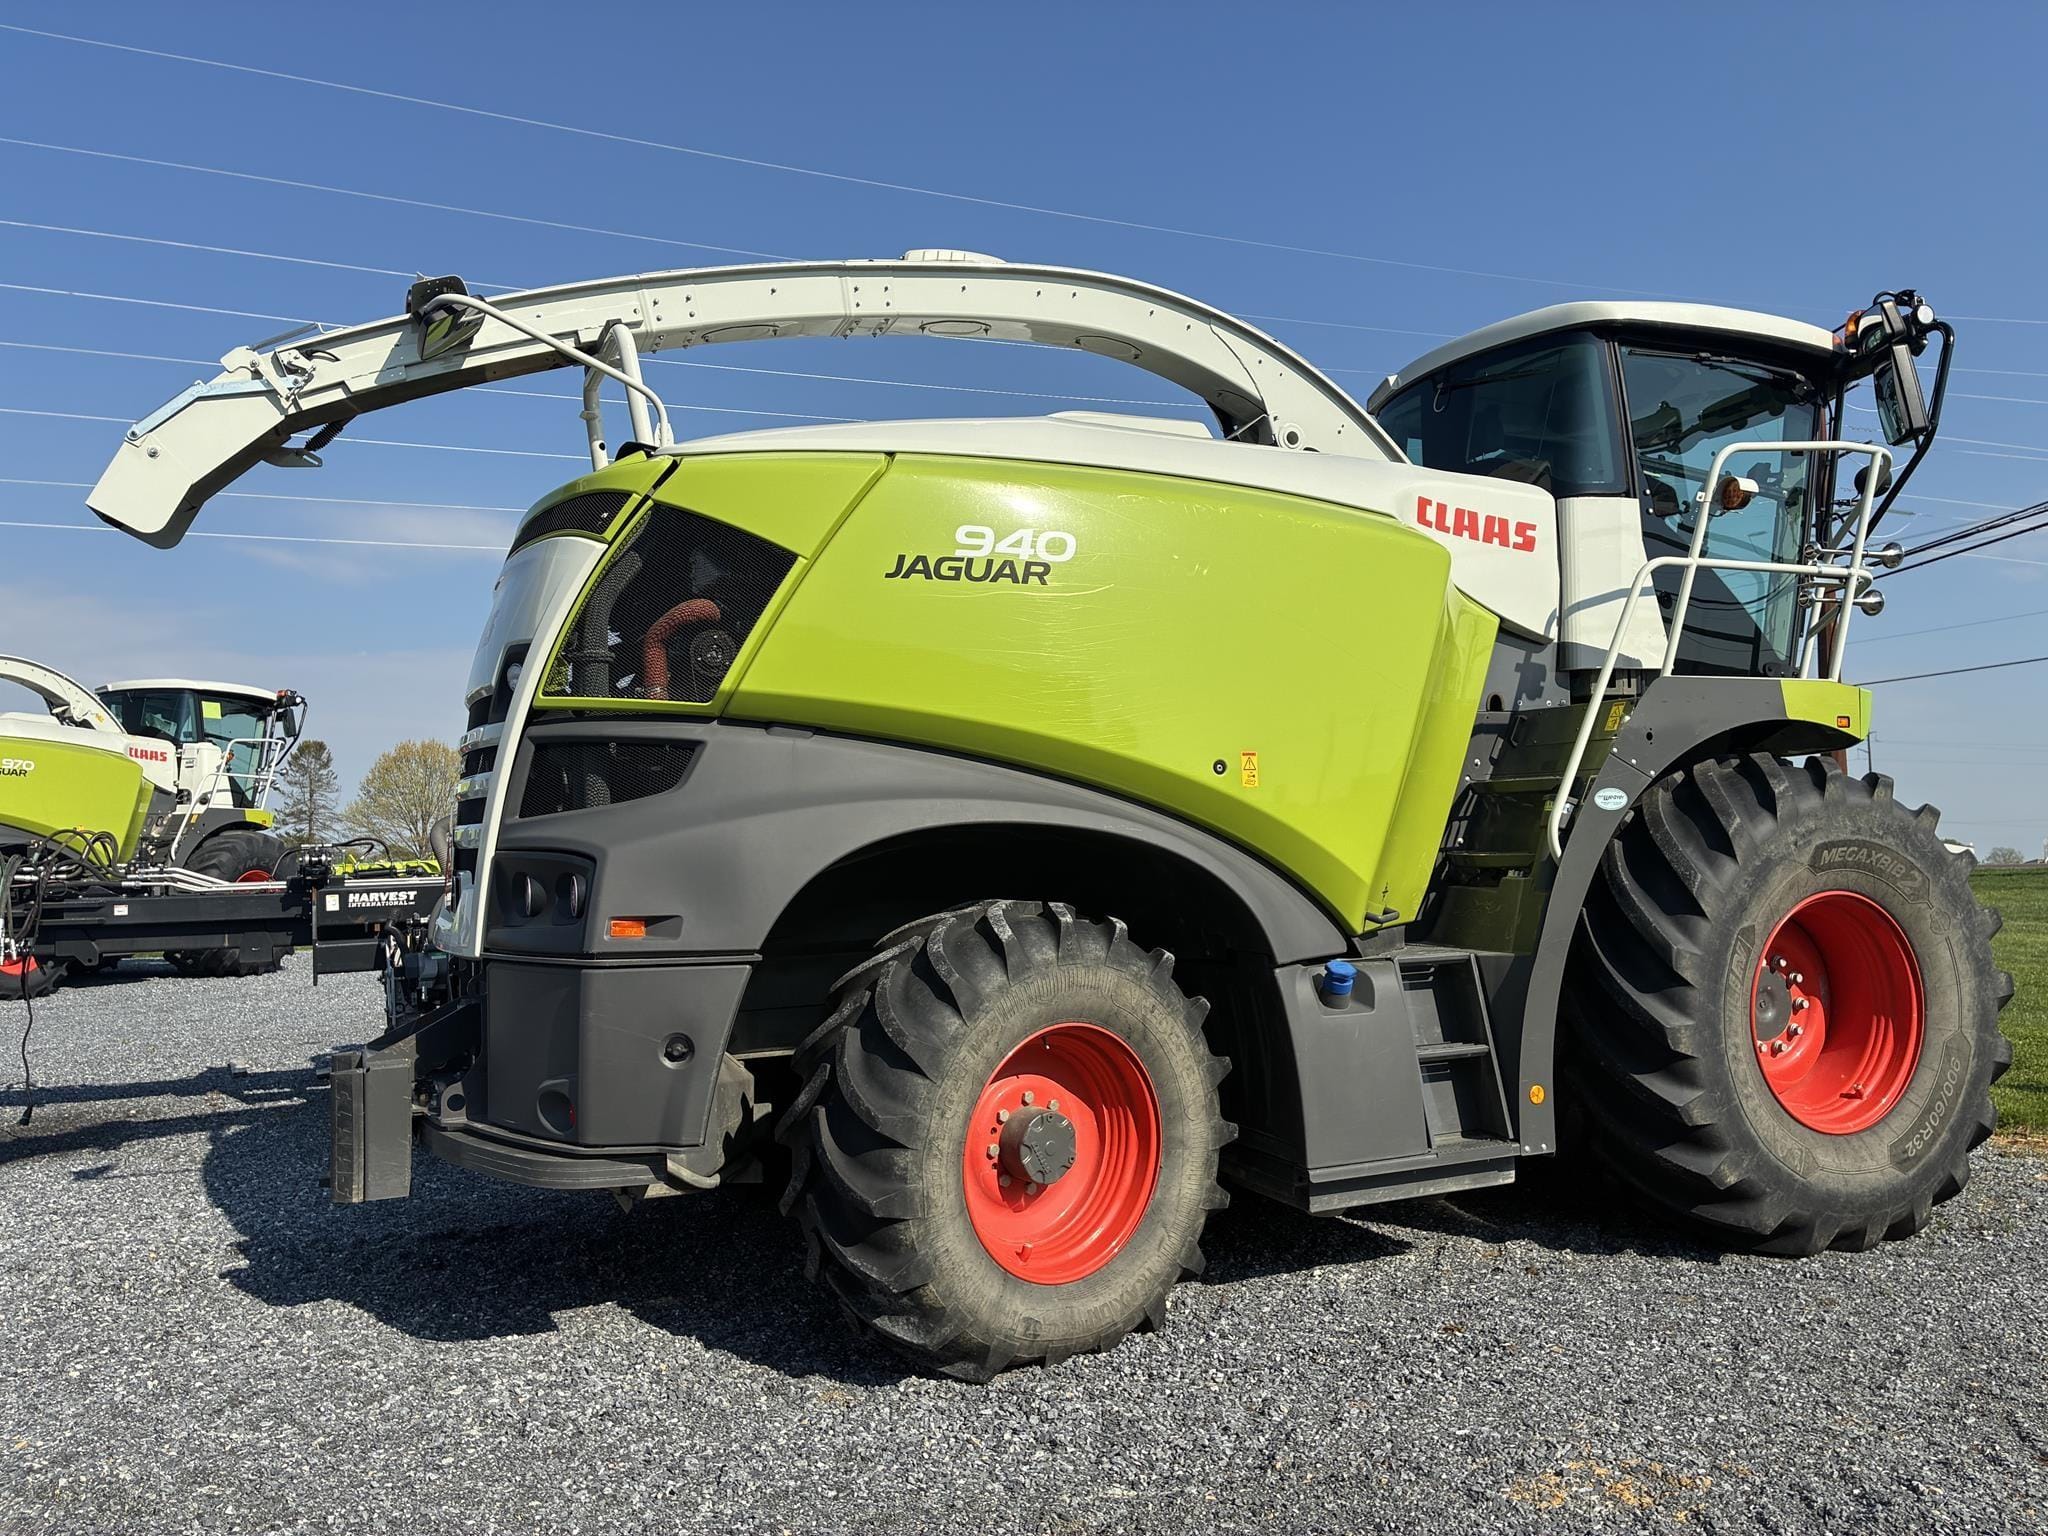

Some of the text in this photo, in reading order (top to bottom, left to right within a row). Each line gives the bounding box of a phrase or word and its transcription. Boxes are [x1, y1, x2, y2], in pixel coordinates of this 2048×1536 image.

[1416, 495, 1537, 553] CLAAS
[954, 524, 1077, 562] 940
[884, 554, 1051, 585] JAGUAR
[2, 758, 35, 770] 970
[128, 746, 168, 762] CLAAS
[348, 890, 418, 902] HARVEST
[348, 900, 408, 908] INTERNATIONAL
[1905, 1056, 1961, 1157] 900/60R32
